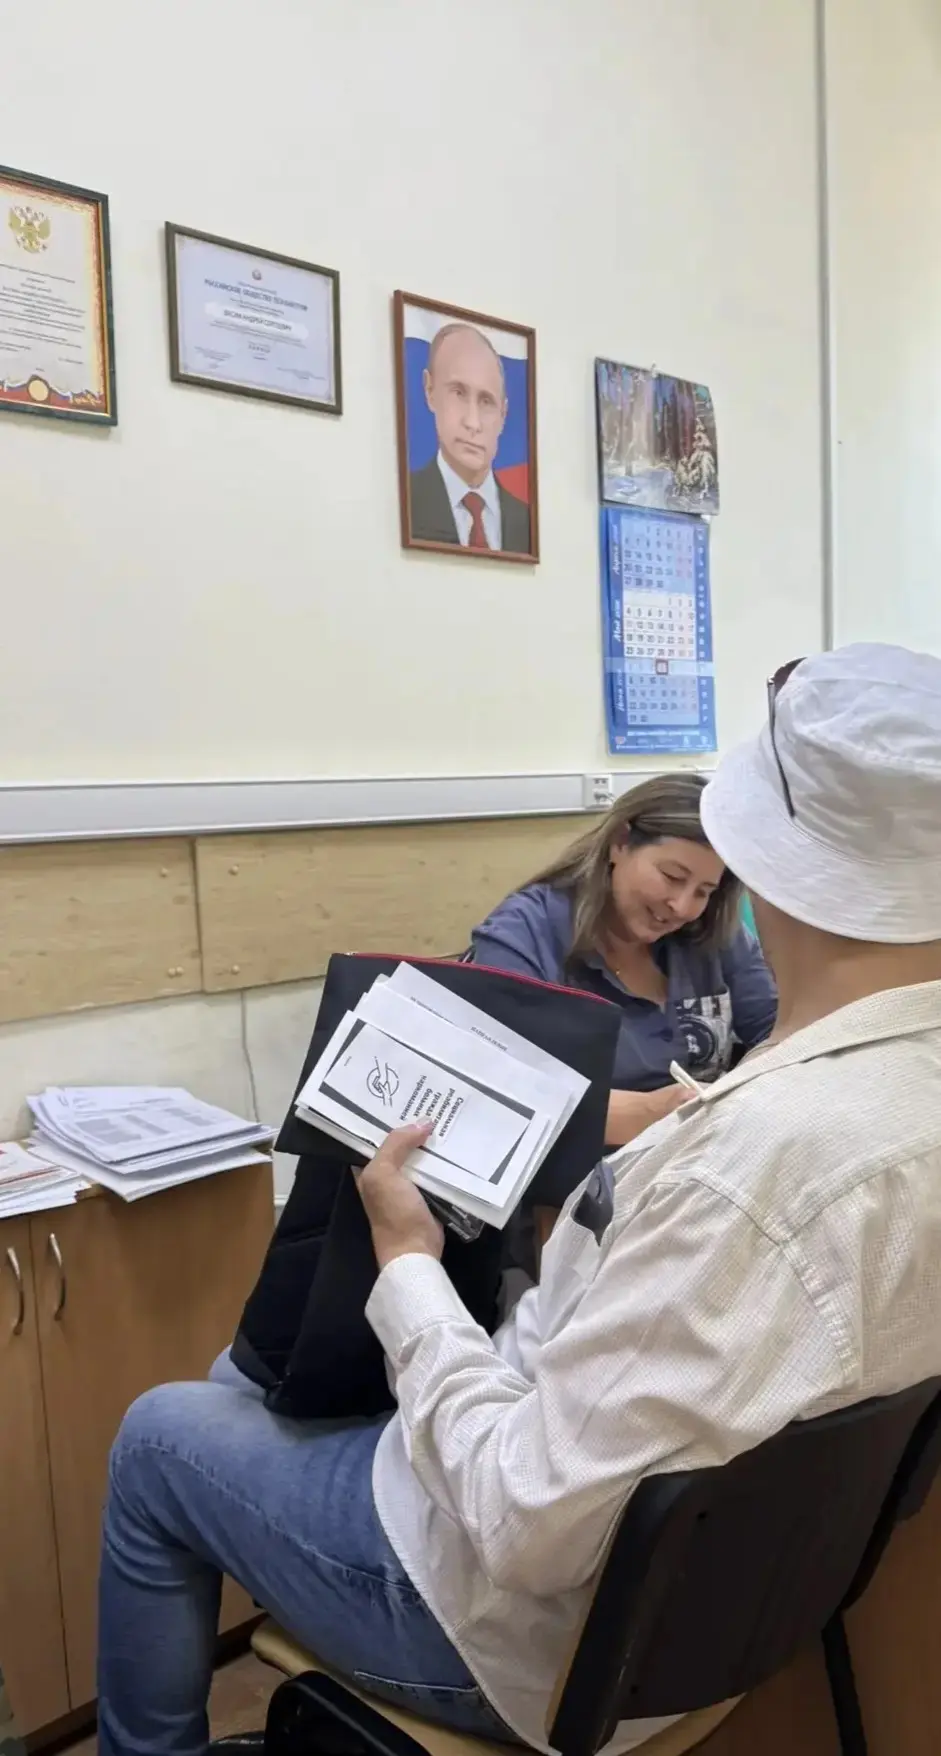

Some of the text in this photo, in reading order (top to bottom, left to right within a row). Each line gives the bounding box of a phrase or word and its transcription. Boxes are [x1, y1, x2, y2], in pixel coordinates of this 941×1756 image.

[399, 1074, 427, 1121] наркоманией
[413, 1088, 434, 1118] больных
[425, 1091, 442, 1117] гражда
[438, 1097, 464, 1137] Социальная
